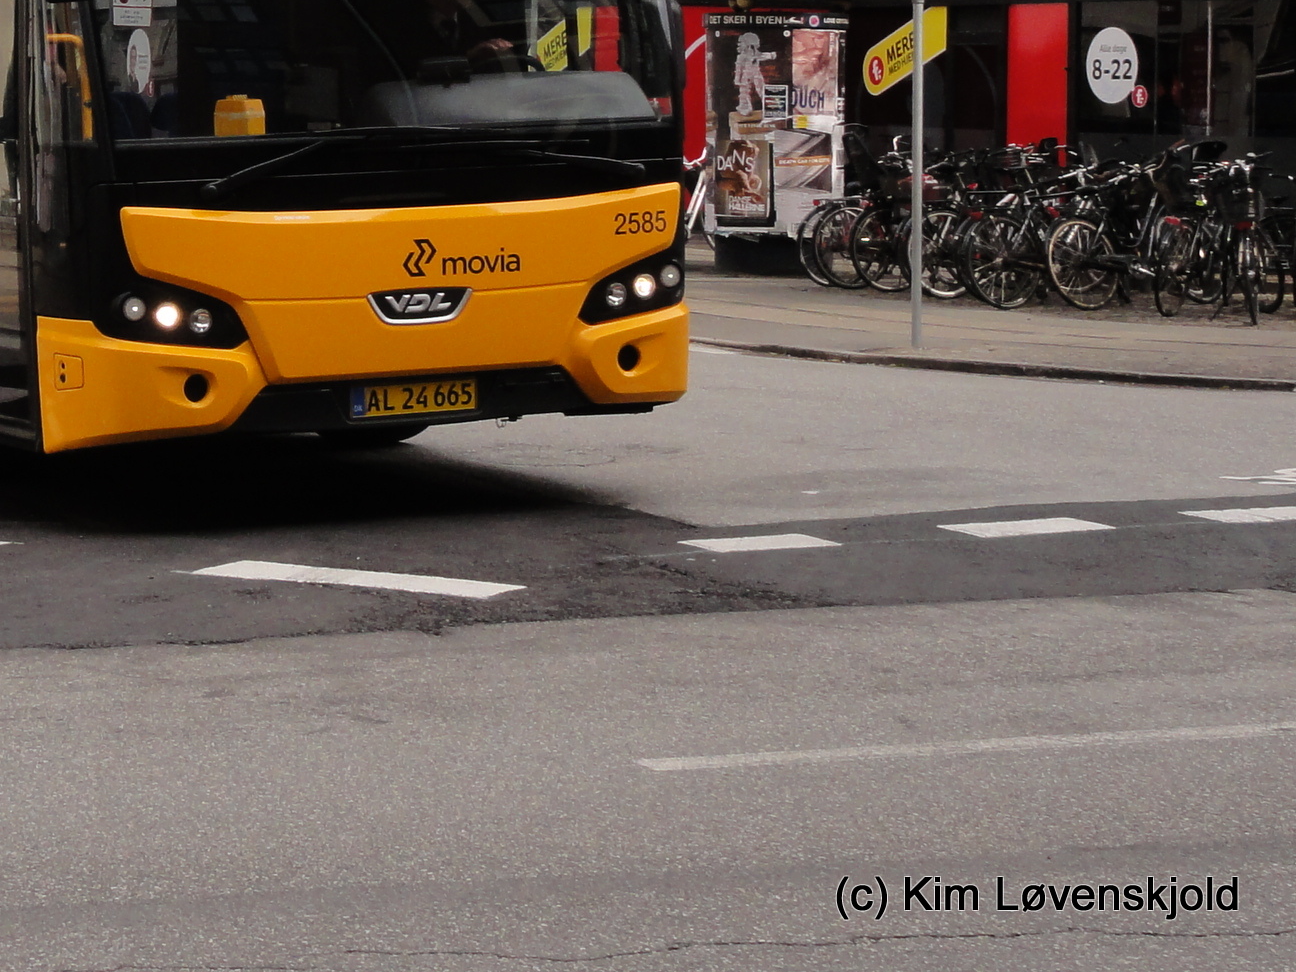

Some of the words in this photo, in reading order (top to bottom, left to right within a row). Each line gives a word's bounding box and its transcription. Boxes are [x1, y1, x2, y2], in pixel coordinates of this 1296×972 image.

[709, 15, 722, 25] DET
[723, 15, 747, 24] SKER
[543, 29, 568, 62] MERE
[886, 31, 914, 65] MERE
[1092, 58, 1133, 80] 8-22
[717, 149, 754, 172] DANS
[614, 210, 667, 236] 2585
[442, 247, 521, 276] movia
[384, 291, 453, 314] VDL
[367, 388, 396, 412] AL
[402, 386, 428, 410] 24
[433, 382, 473, 407] 665
